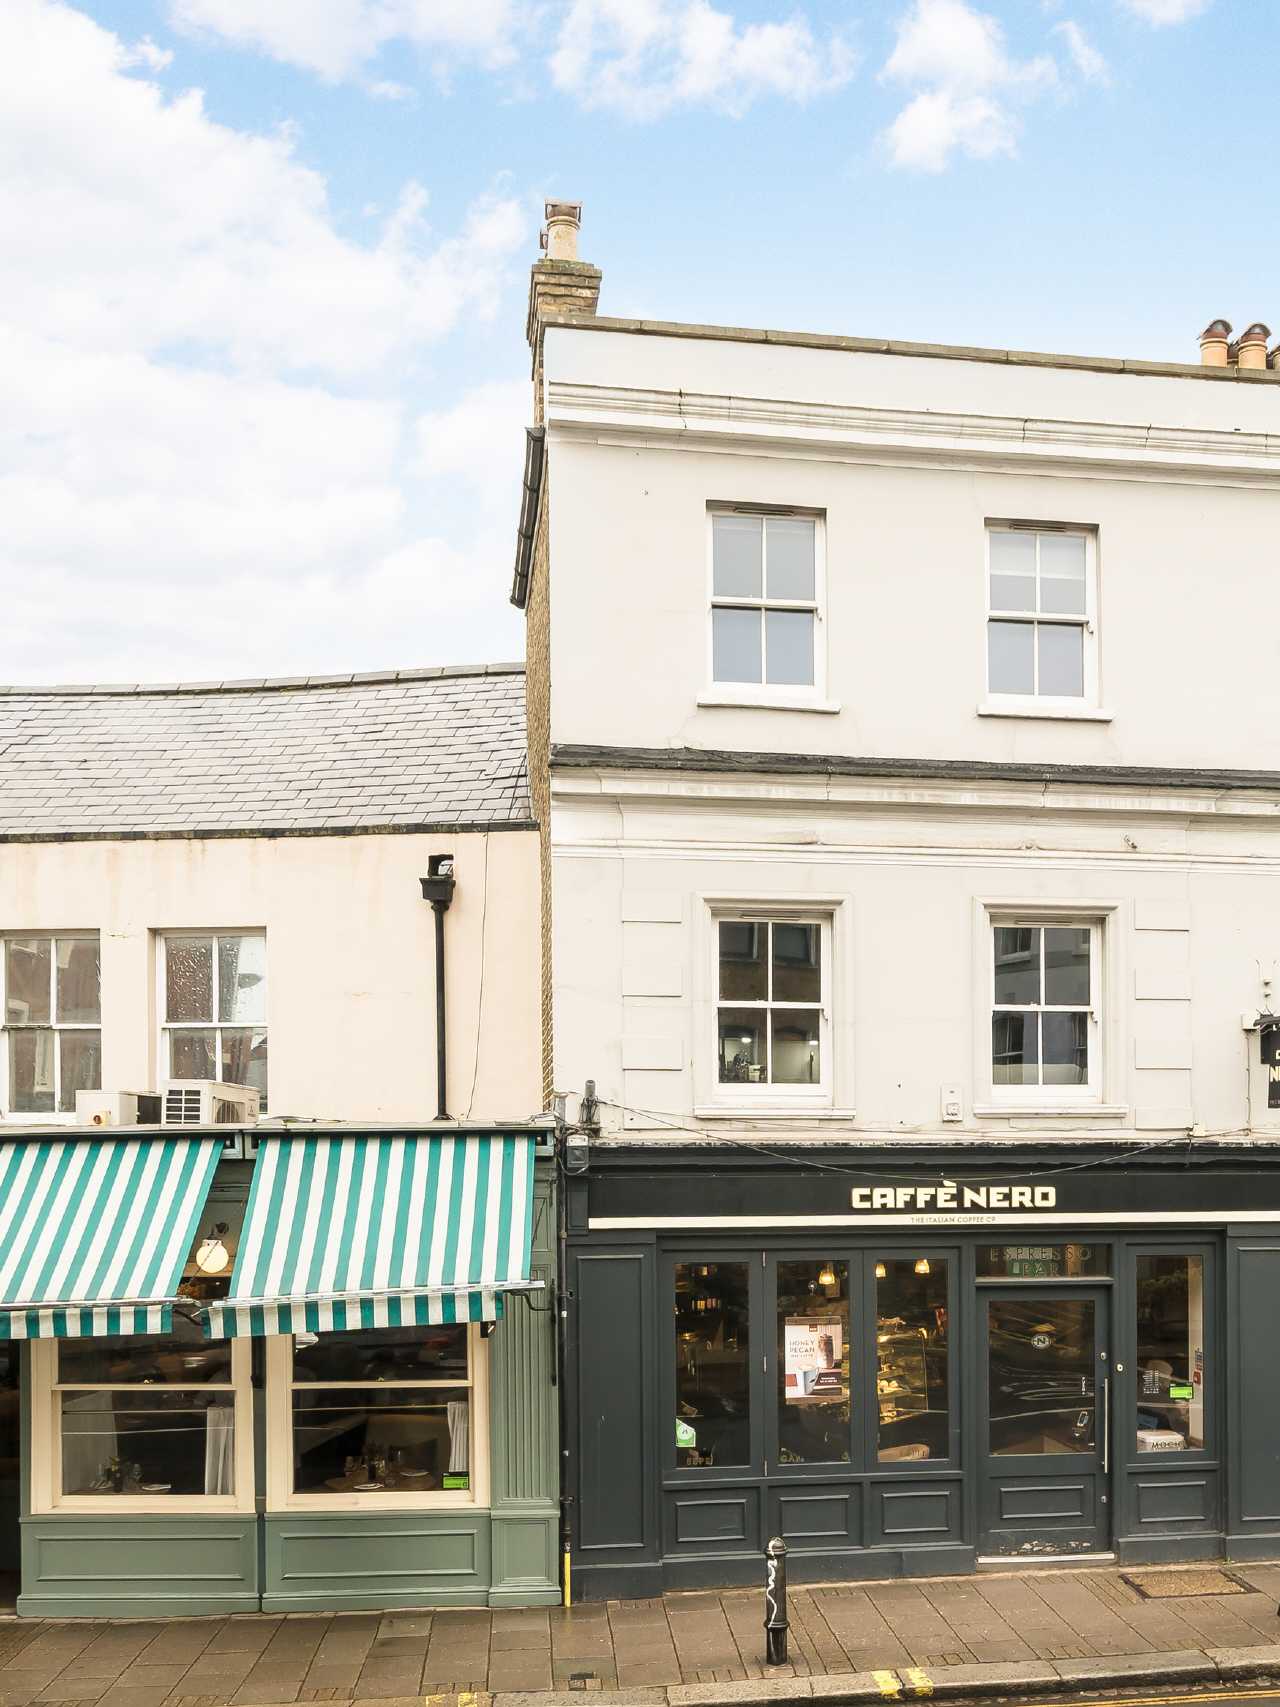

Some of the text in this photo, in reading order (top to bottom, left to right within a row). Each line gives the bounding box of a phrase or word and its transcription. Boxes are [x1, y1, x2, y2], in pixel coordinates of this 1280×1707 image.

[851, 1180, 1057, 1209] CAFFÈ NERO
[911, 1216, 924, 1224] THE
[990, 1245, 1092, 1262] ESPRESSO
